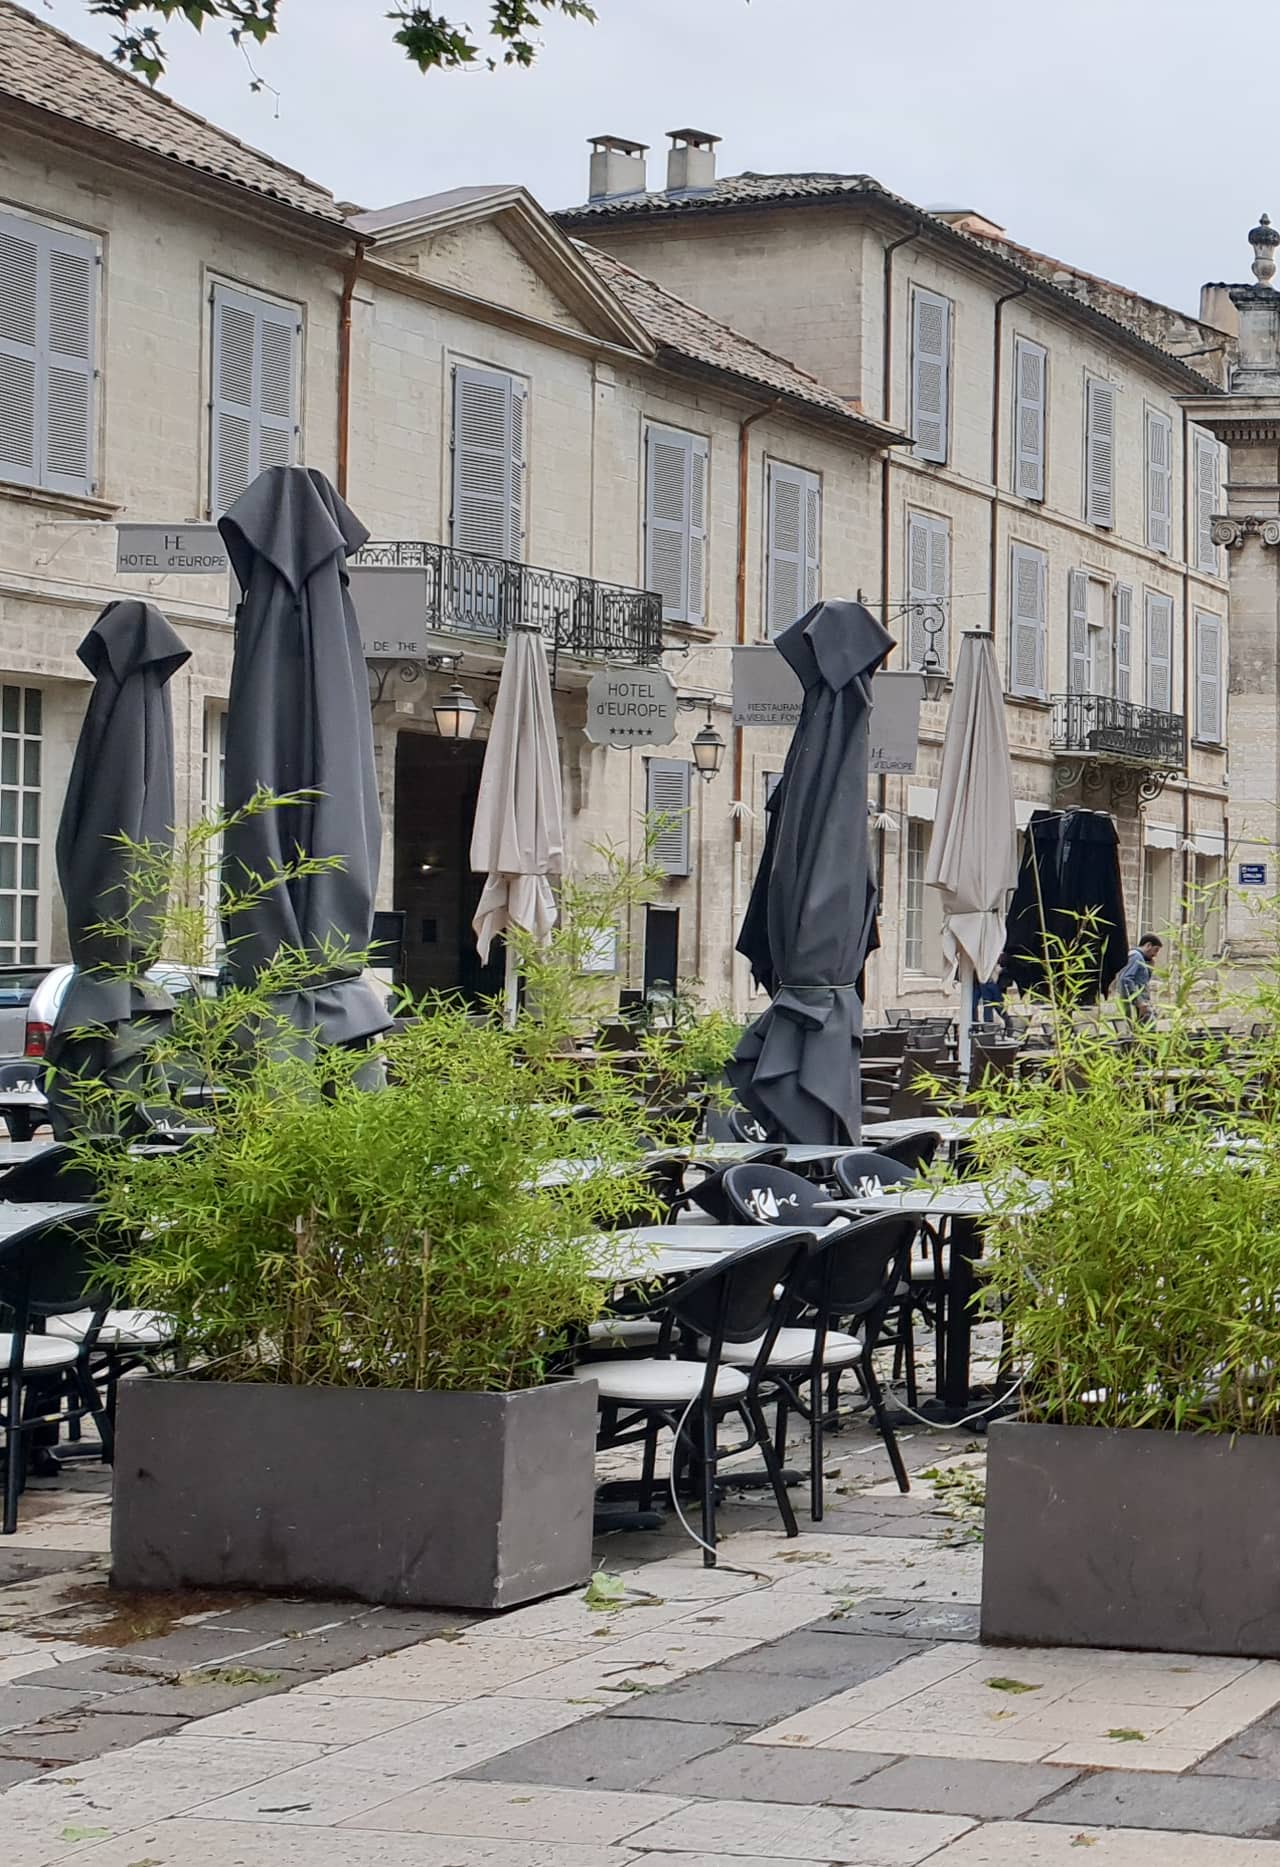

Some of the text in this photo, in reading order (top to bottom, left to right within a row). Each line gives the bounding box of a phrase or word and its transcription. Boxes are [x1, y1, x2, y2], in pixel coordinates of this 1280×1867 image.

[120, 554, 225, 567] HOTEL d'EUROPE
[373, 640, 390, 651] DE
[608, 682, 655, 698] HOTEL
[596, 701, 668, 718] d'EUROPE
[747, 703, 801, 712] RESTAURAN
